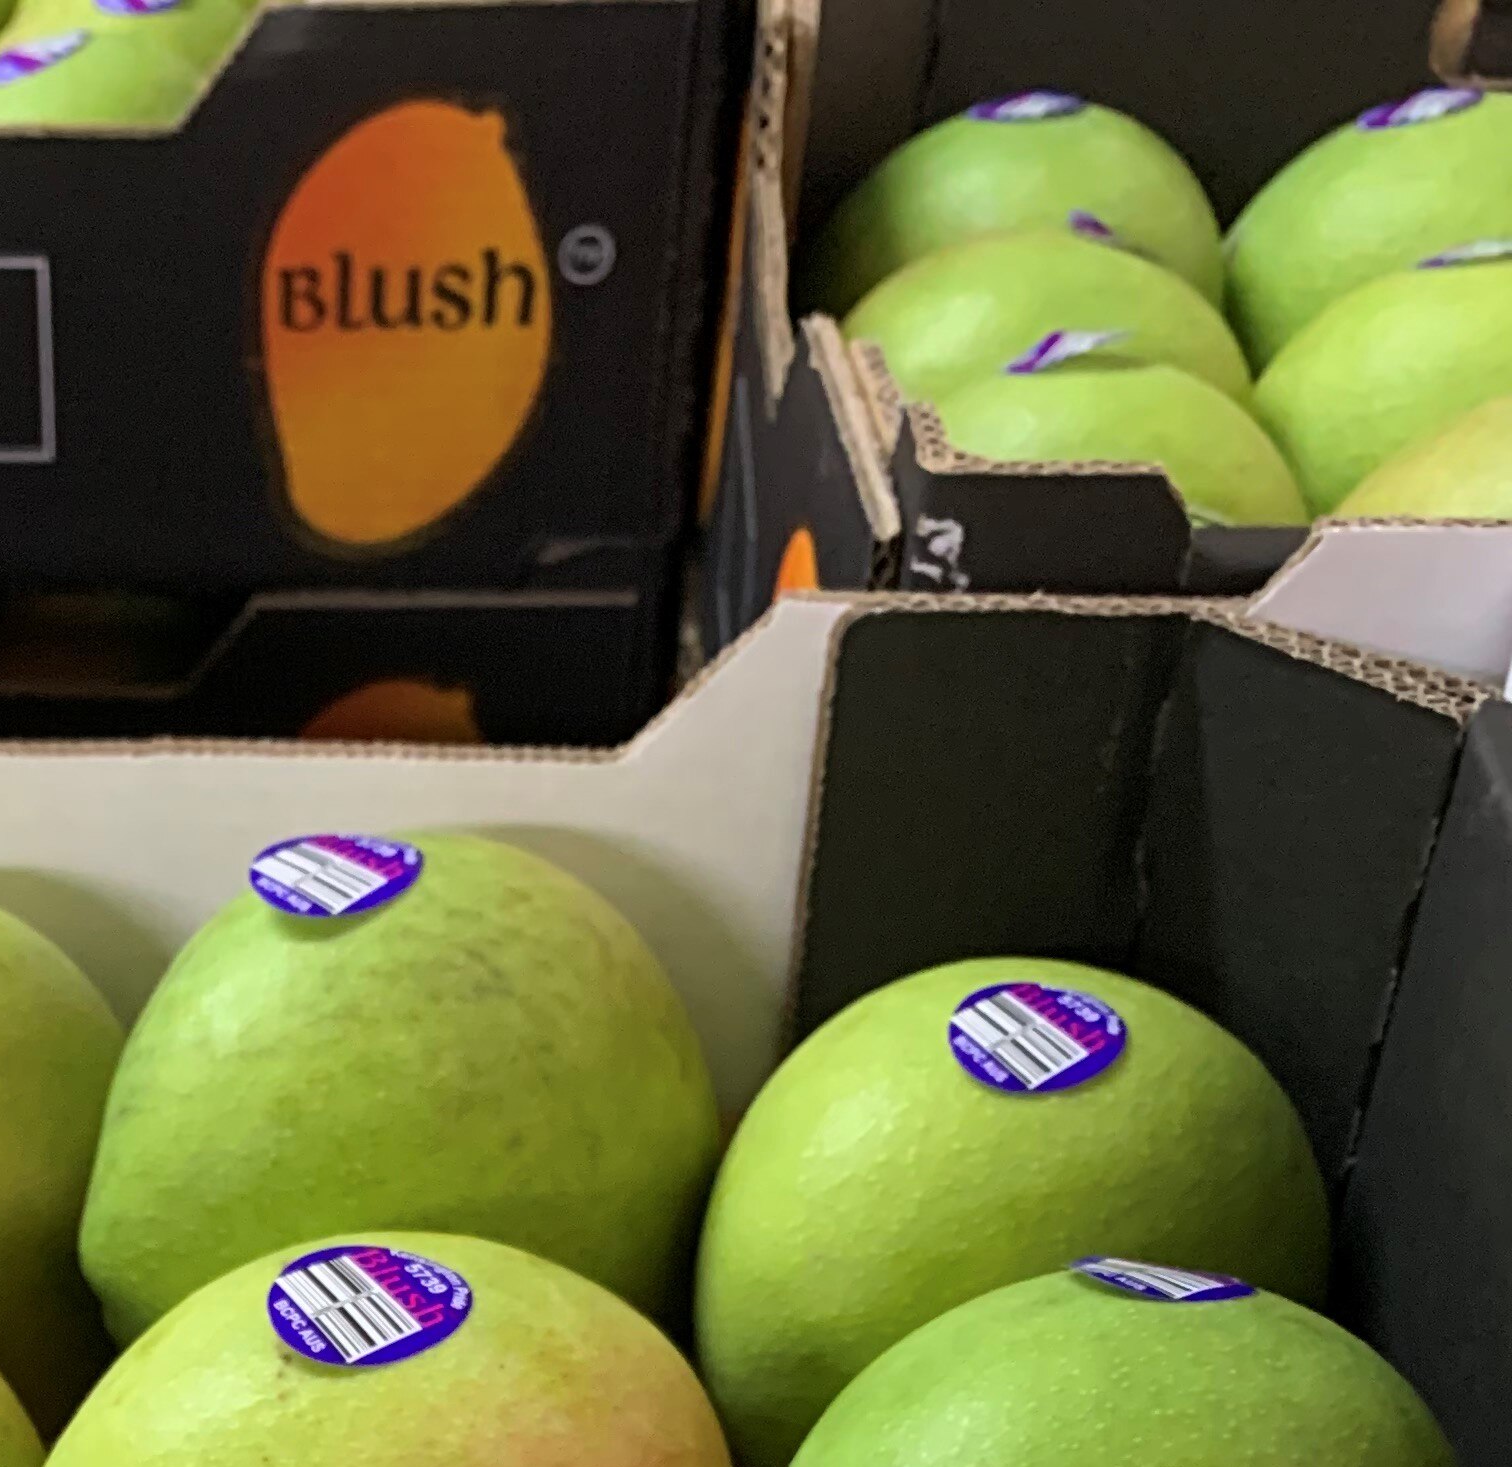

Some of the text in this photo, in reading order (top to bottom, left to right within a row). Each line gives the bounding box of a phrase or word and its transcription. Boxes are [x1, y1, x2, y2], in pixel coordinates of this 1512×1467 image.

[277, 247, 537, 332] Blush
[349, 1249, 445, 1329] Blush
[404, 1262, 449, 1295] 5739
[273, 1299, 327, 1354] BCPC AUS
